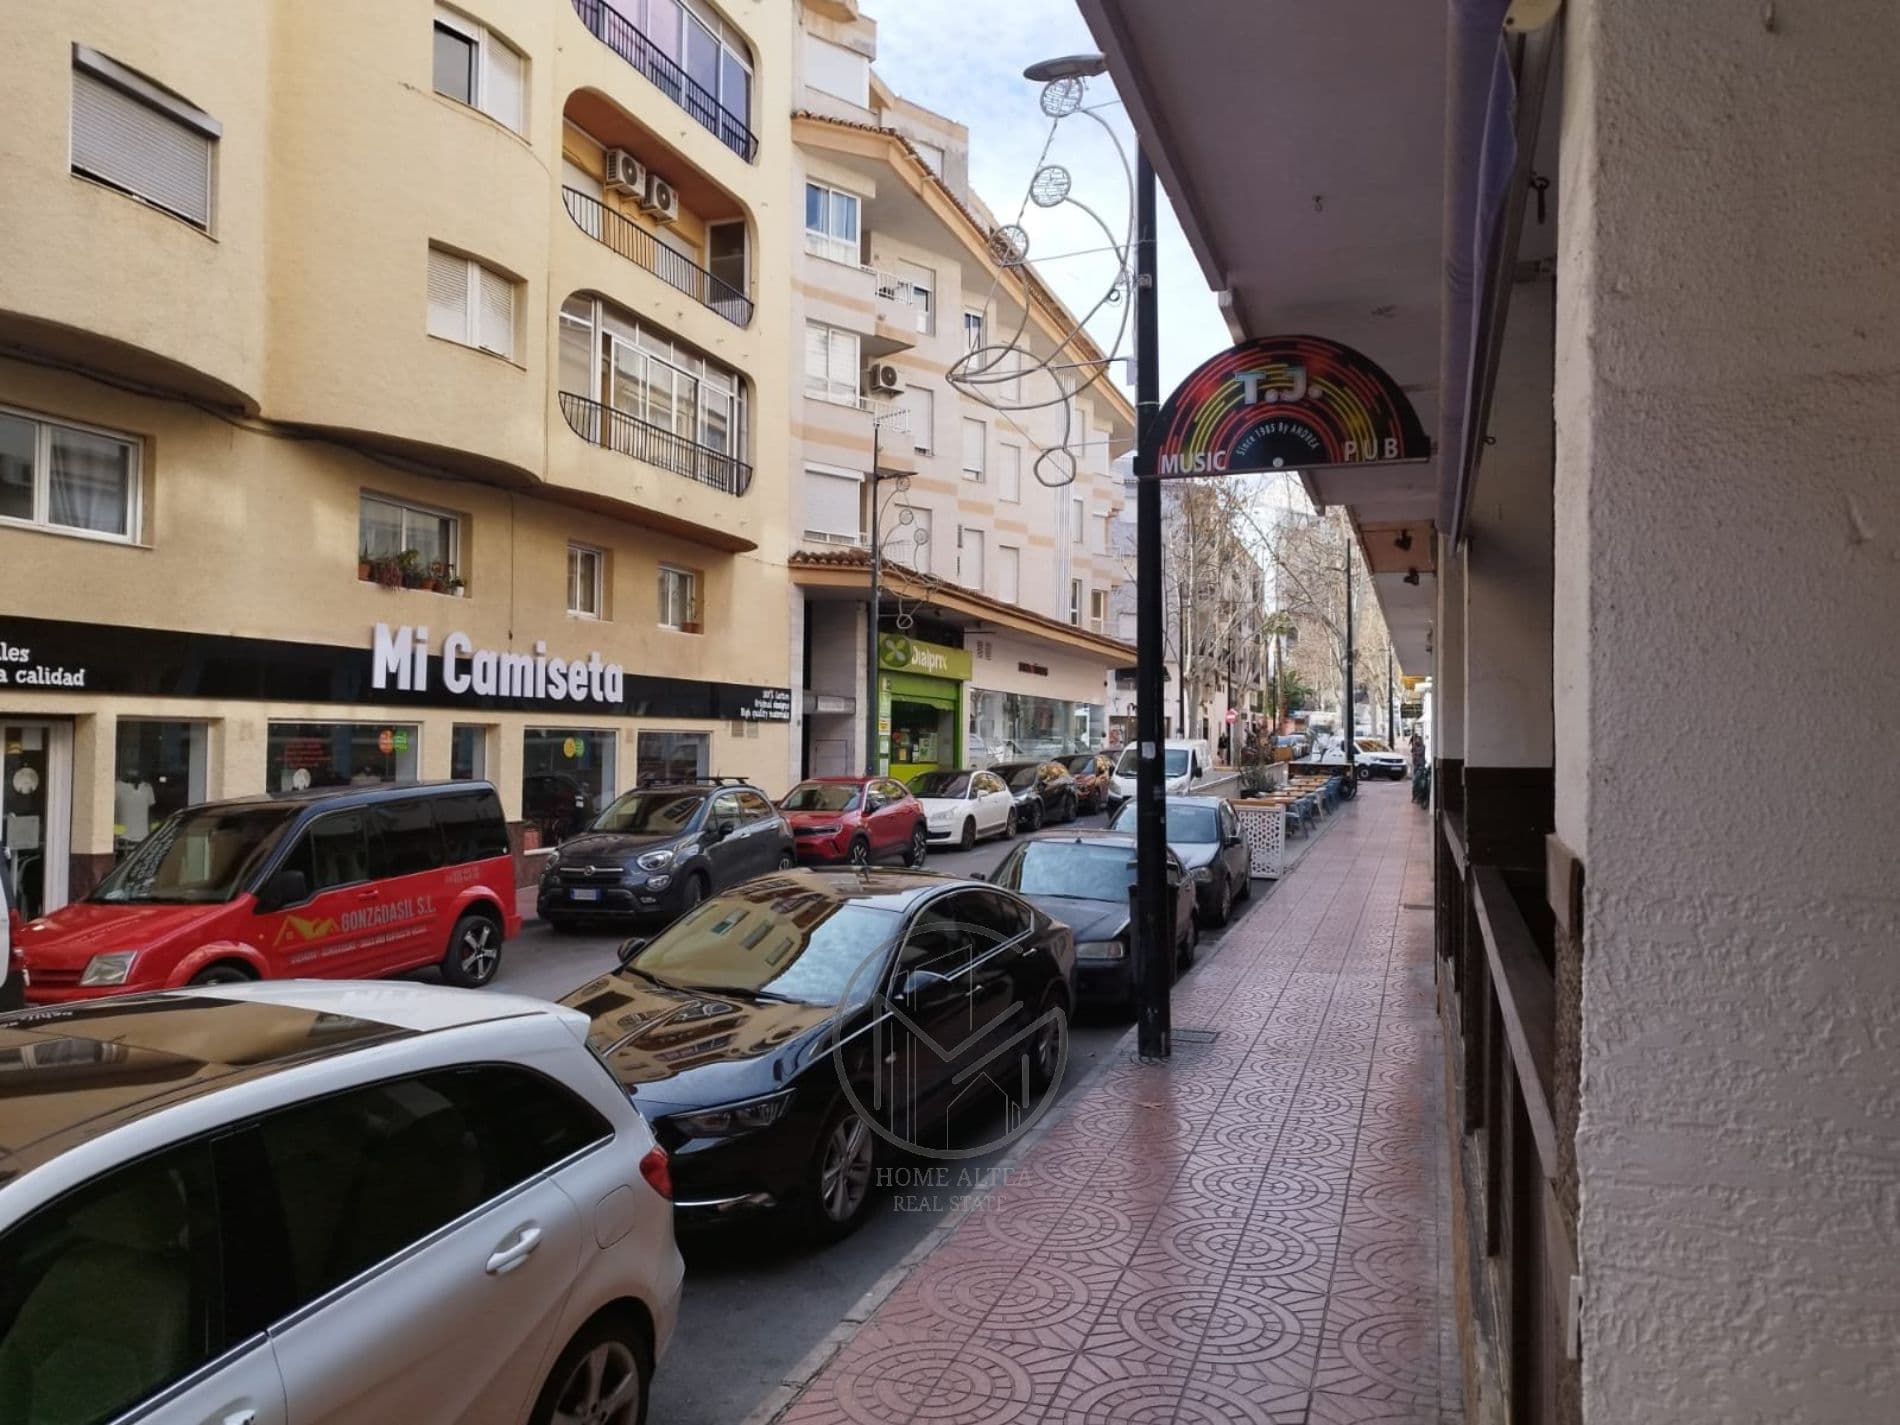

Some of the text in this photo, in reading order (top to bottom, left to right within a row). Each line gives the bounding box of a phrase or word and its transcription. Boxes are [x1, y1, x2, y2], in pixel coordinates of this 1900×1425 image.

[1235, 368, 1323, 404] T.J.
[1161, 450, 1227, 474] MUSIC
[15, 665, 86, 687] calidad
[372, 622, 624, 703] Mi Camiseta
